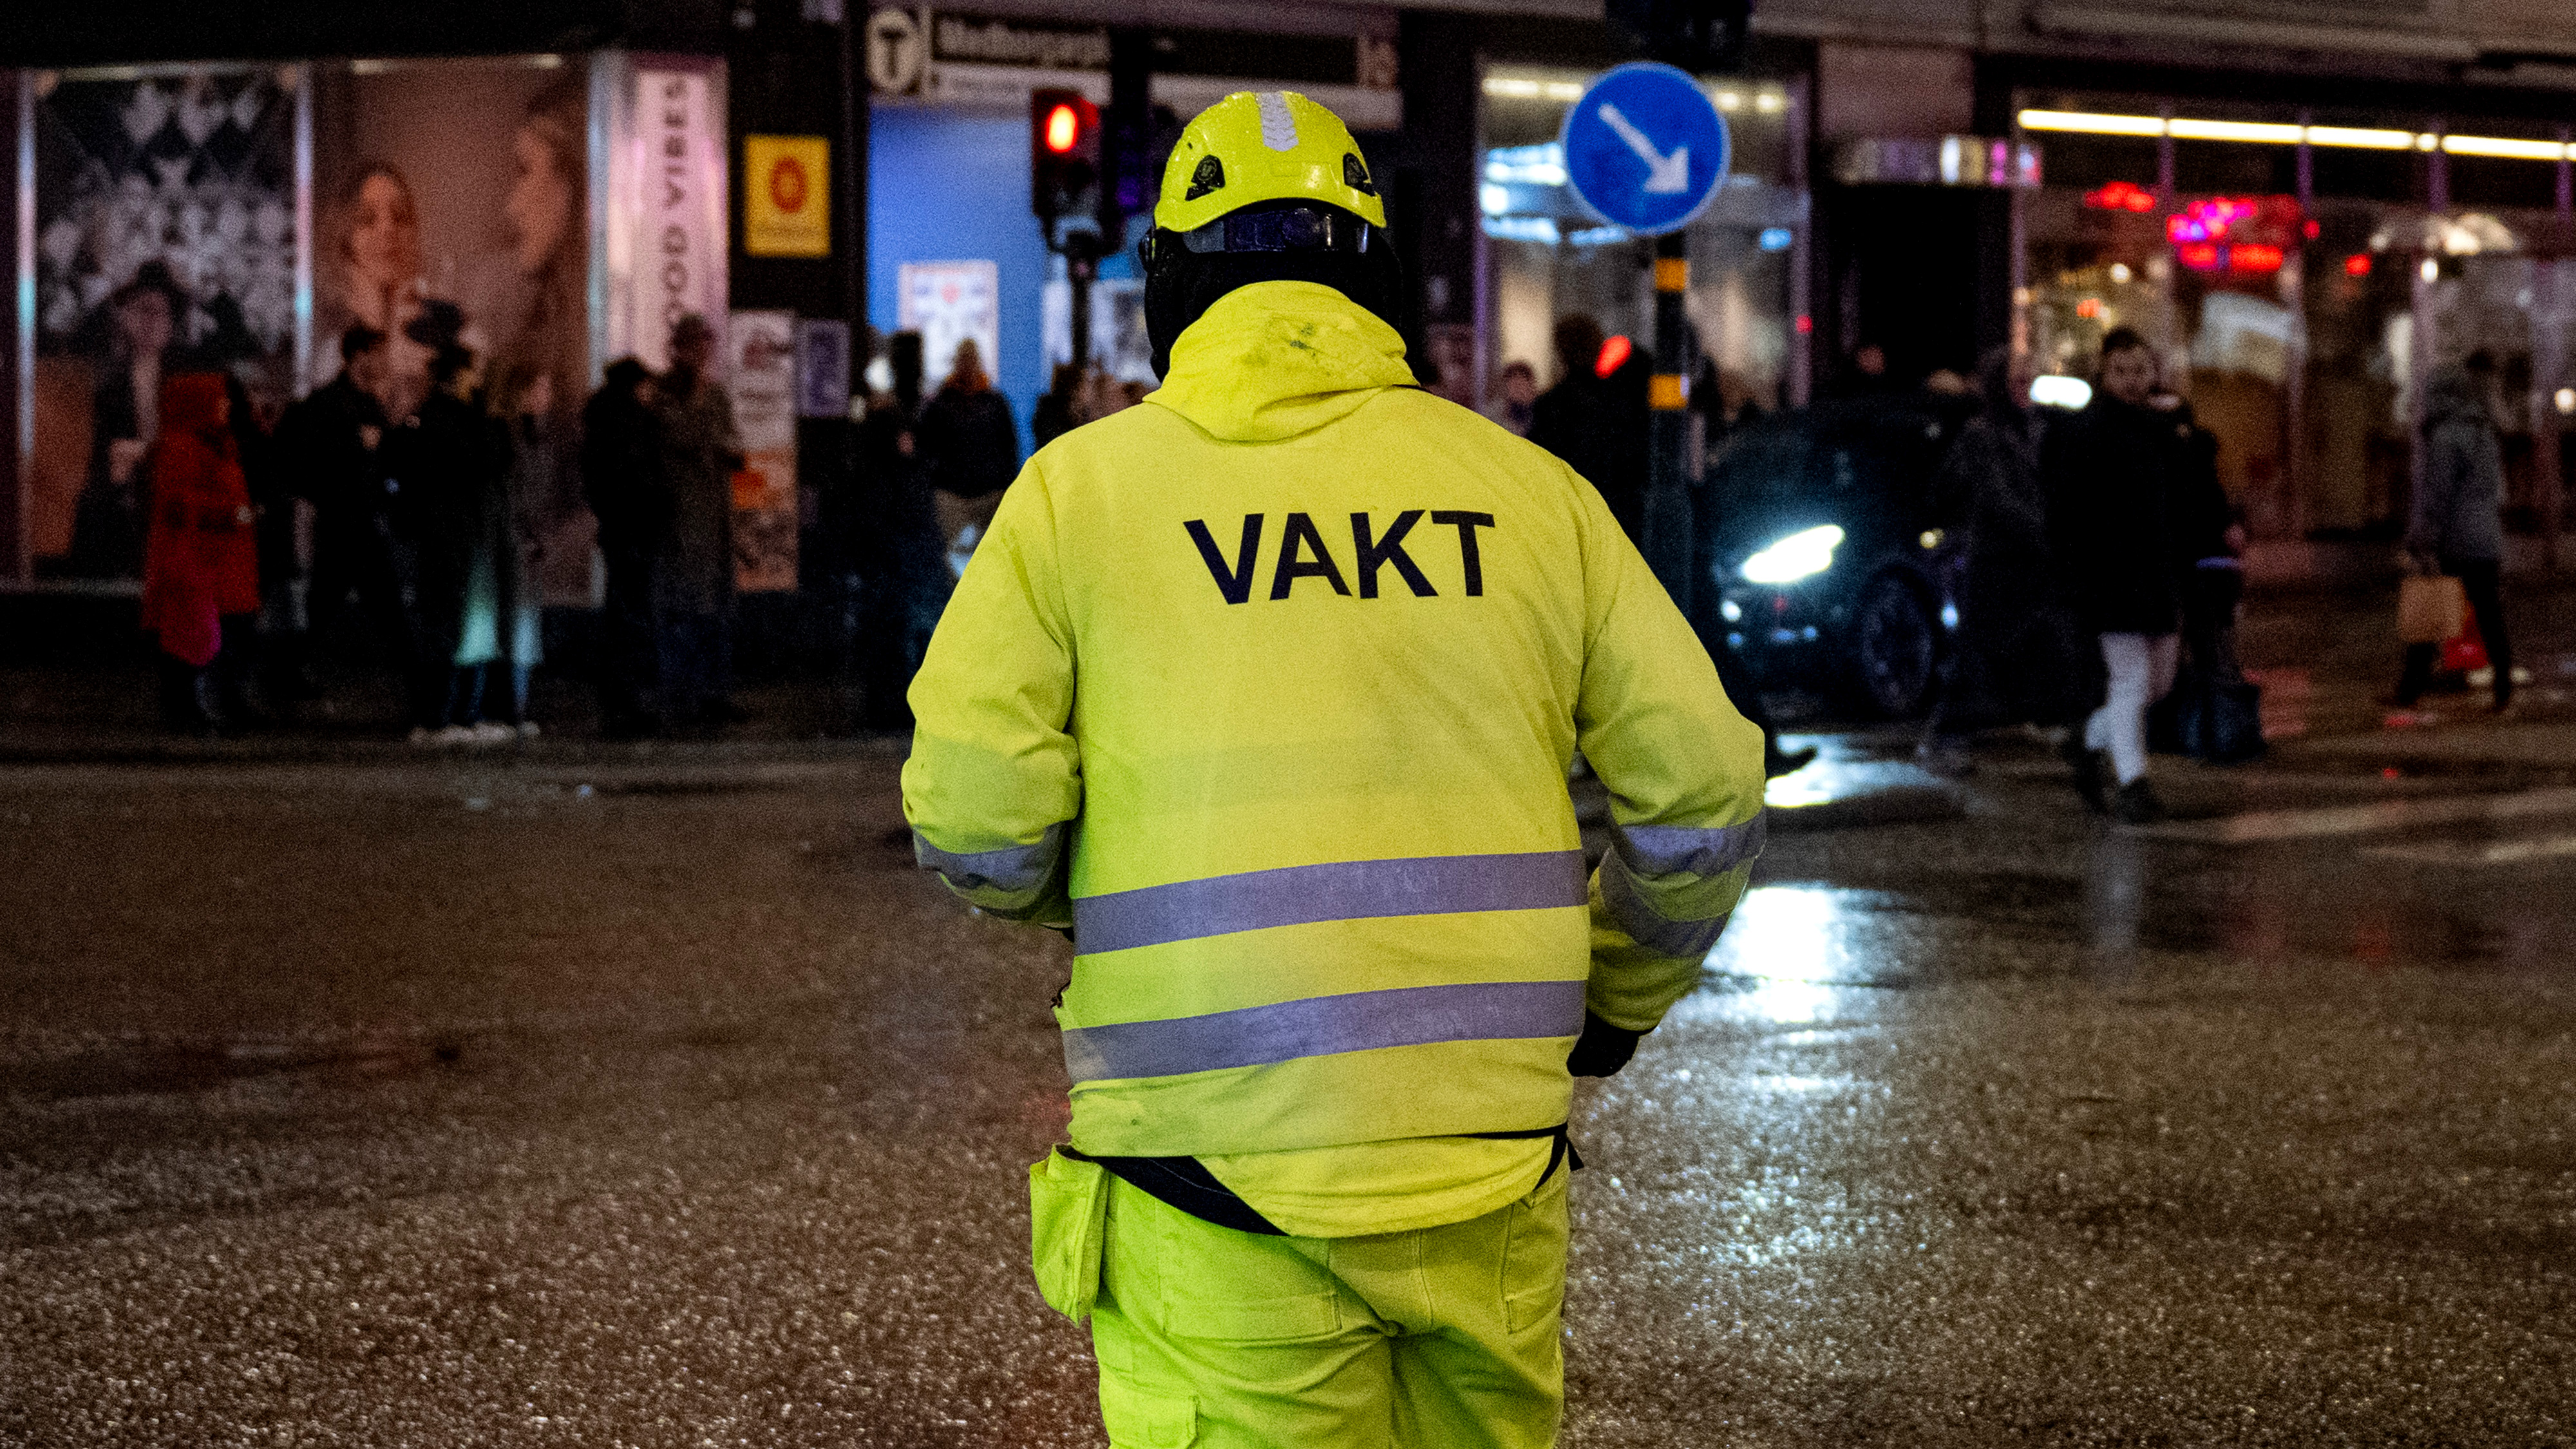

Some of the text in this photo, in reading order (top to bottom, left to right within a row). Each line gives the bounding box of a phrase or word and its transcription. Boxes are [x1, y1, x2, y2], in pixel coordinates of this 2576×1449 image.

[878, 28, 907, 80] T
[661, 79, 688, 348] OOD VIBES
[1183, 509, 1495, 605] VAKT
